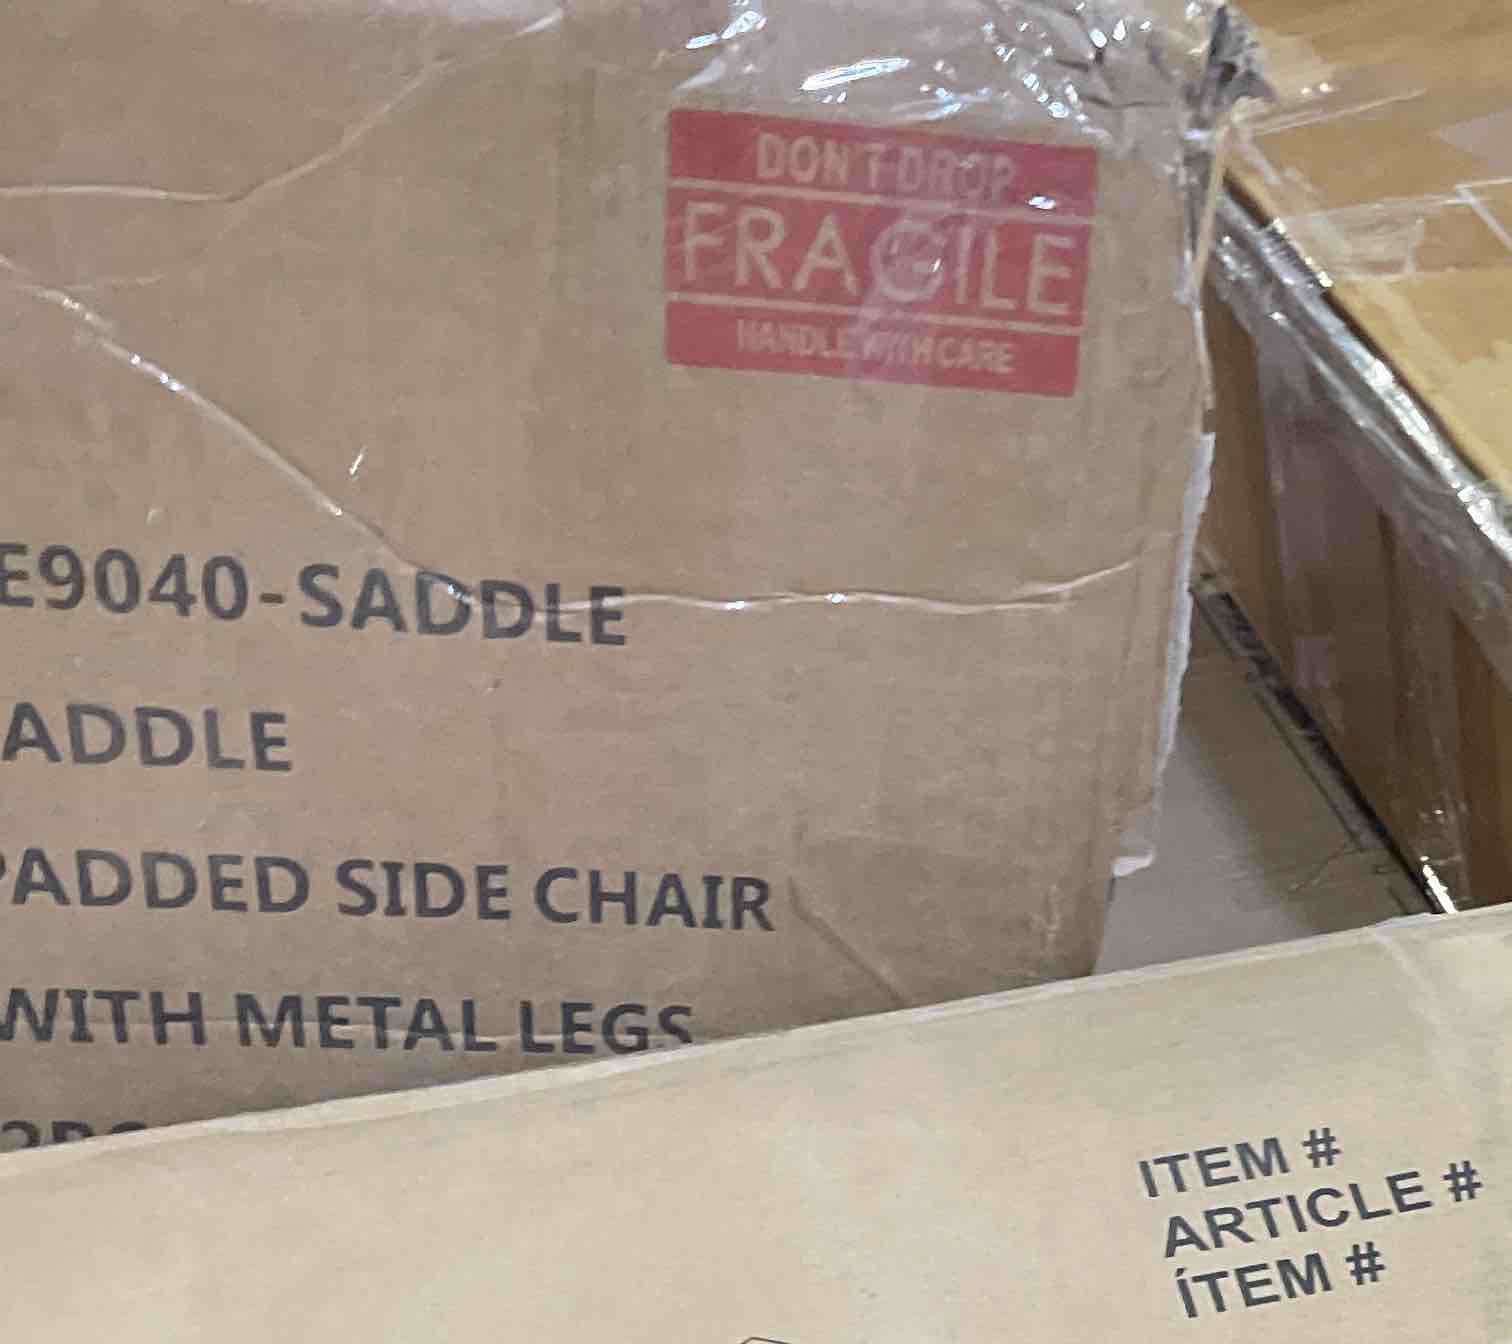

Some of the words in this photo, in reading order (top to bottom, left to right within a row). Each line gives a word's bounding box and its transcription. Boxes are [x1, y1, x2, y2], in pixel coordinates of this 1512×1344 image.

[756, 131, 885, 189] DONT
[681, 201, 1076, 317] FRAGILE
[0, 542, 627, 647] E9040-SADDLE
[0, 847, 310, 914] ADDED
[335, 858, 512, 921] SIDE
[534, 866, 775, 932] CHAIR
[0, 987, 206, 1046] WITH
[235, 993, 499, 1053] METAL
[519, 999, 694, 1056] LEGS
[1137, 1136, 1292, 1199] ITEM
[1300, 1126, 1343, 1170] #
[1163, 1169, 1435, 1260] ARTICLE
[1441, 1159, 1485, 1204] #
[1173, 1251, 1334, 1320] ÍTEM
[1343, 1239, 1387, 1287] #
